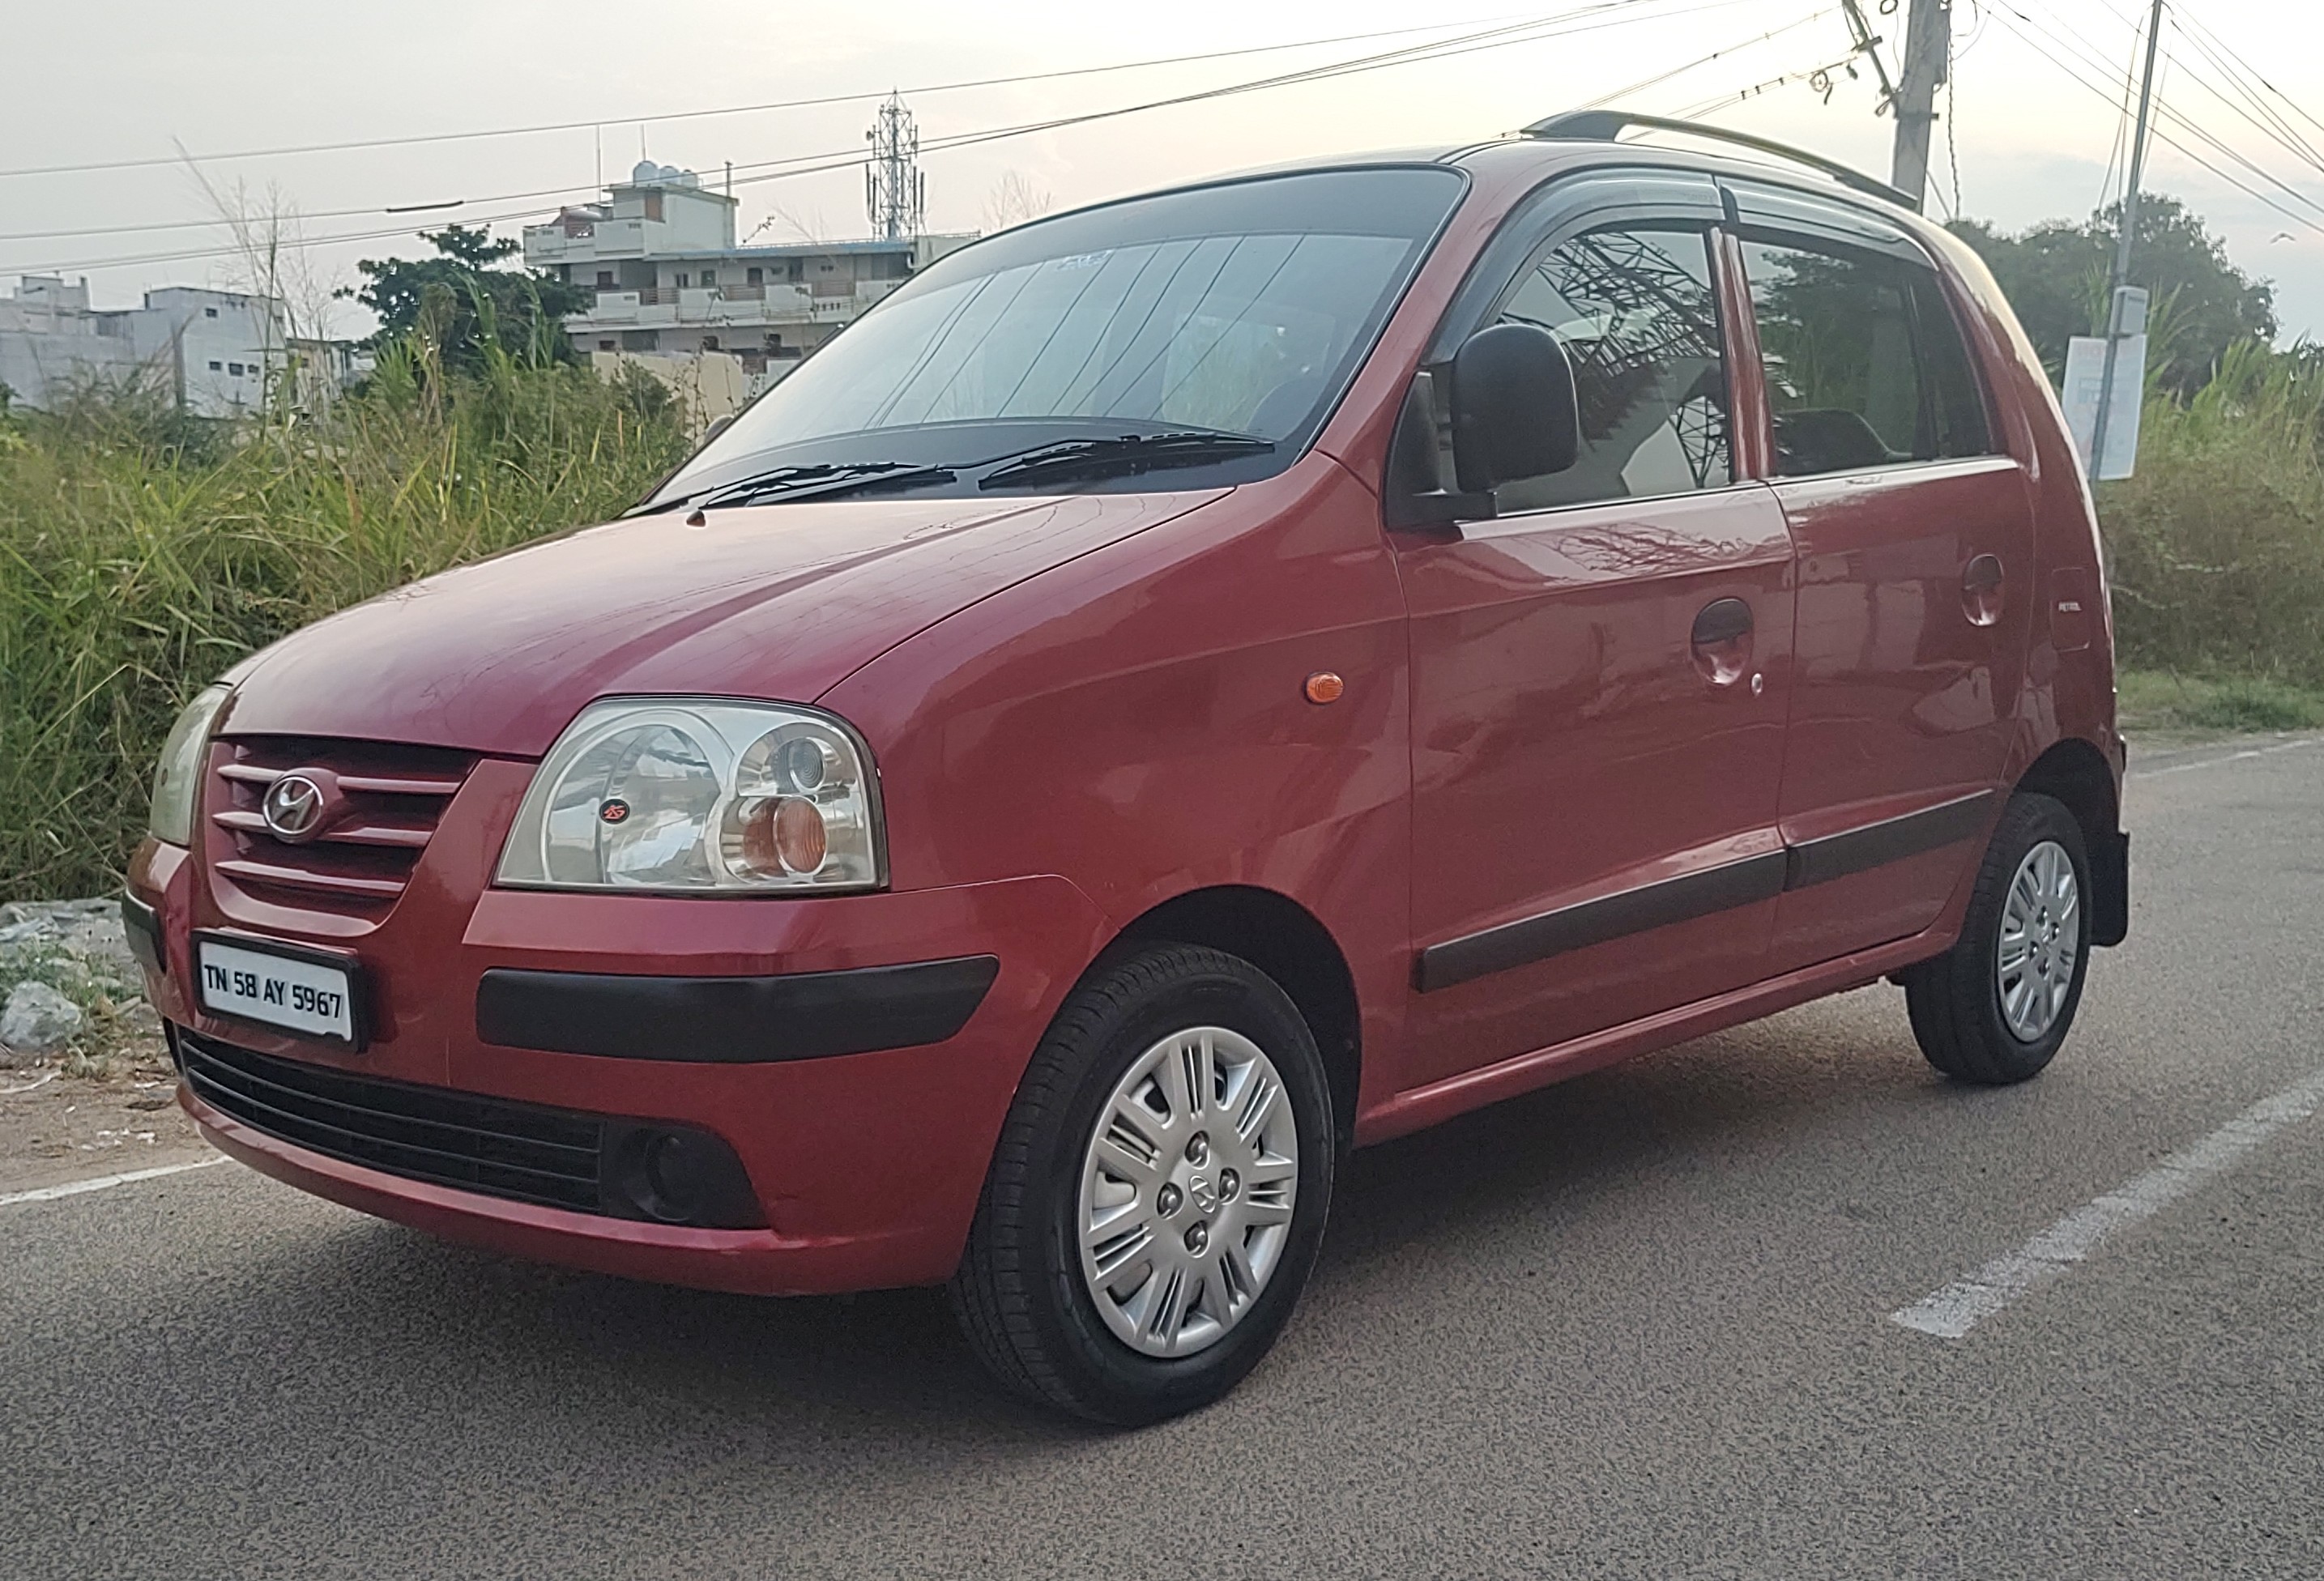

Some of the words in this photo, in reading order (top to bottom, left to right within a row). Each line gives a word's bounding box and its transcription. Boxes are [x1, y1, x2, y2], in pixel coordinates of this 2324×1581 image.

[204, 964, 228, 992] TN
[234, 971, 258, 998] 58
[263, 978, 286, 1006] AY
[292, 984, 341, 1019] 5967
